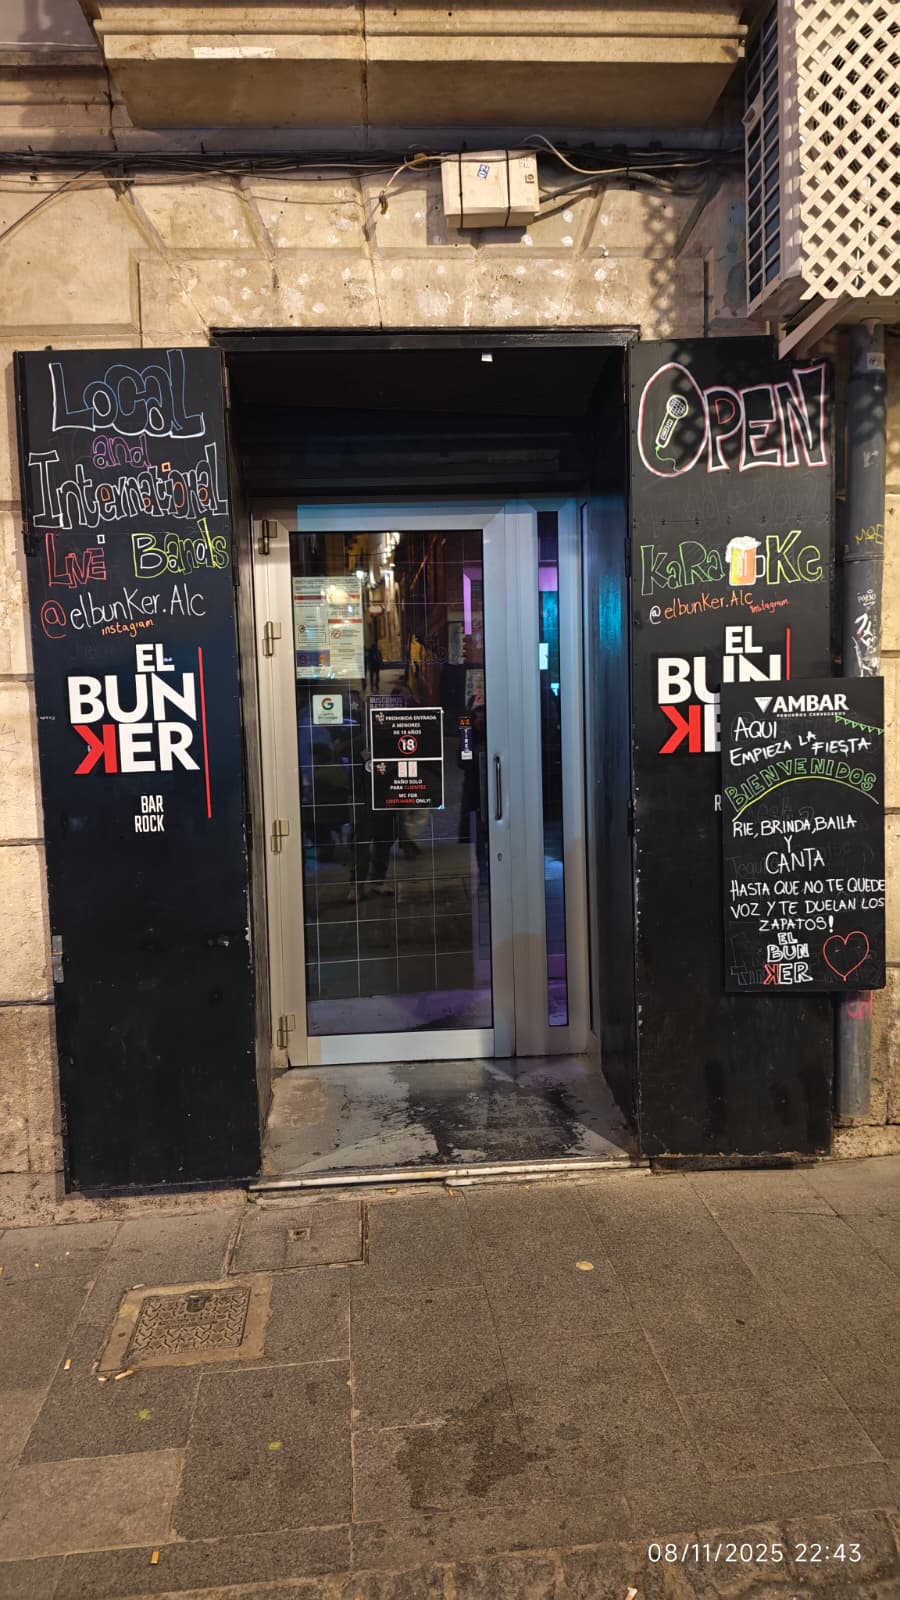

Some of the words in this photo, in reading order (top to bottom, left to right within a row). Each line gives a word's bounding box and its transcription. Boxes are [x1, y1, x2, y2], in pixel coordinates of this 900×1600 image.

[93, 434, 152, 468] and
[131, 517, 230, 578] Bands
[727, 626, 763, 654] EL
[135, 643, 175, 672] EL
[67, 672, 197, 724] BUN
[772, 693, 850, 713] AMBAR
[733, 716, 777, 742] AQUI
[73, 721, 201, 775] KER
[400, 738, 415, 752] 18
[729, 740, 792, 767] EMPIEZA
[798, 731, 816, 747] LA
[811, 737, 872, 757] FIESTA
[724, 757, 876, 812] BIENVENIDOS
[140, 795, 164, 814] BAR
[134, 814, 165, 833] ROCK
[784, 835, 793, 854] Y
[765, 848, 825, 875] CANTA
[730, 880, 770, 902] HASTA
[774, 881, 799, 896] QUE
[803, 881, 824, 896] NO
[825, 878, 844, 892] TE
[847, 877, 886, 893] QUEDE
[730, 902, 760, 919] VOZ
[766, 901, 776, 917] Y
[778, 900, 798, 916] TE
[804, 898, 857, 914] DUELAN
[861, 897, 886, 910] LOS
[758, 915, 834, 933] ZAPATOS!
[777, 932, 798, 946] EL
[766, 943, 810, 963] BUN
[763, 962, 814, 986] KER
